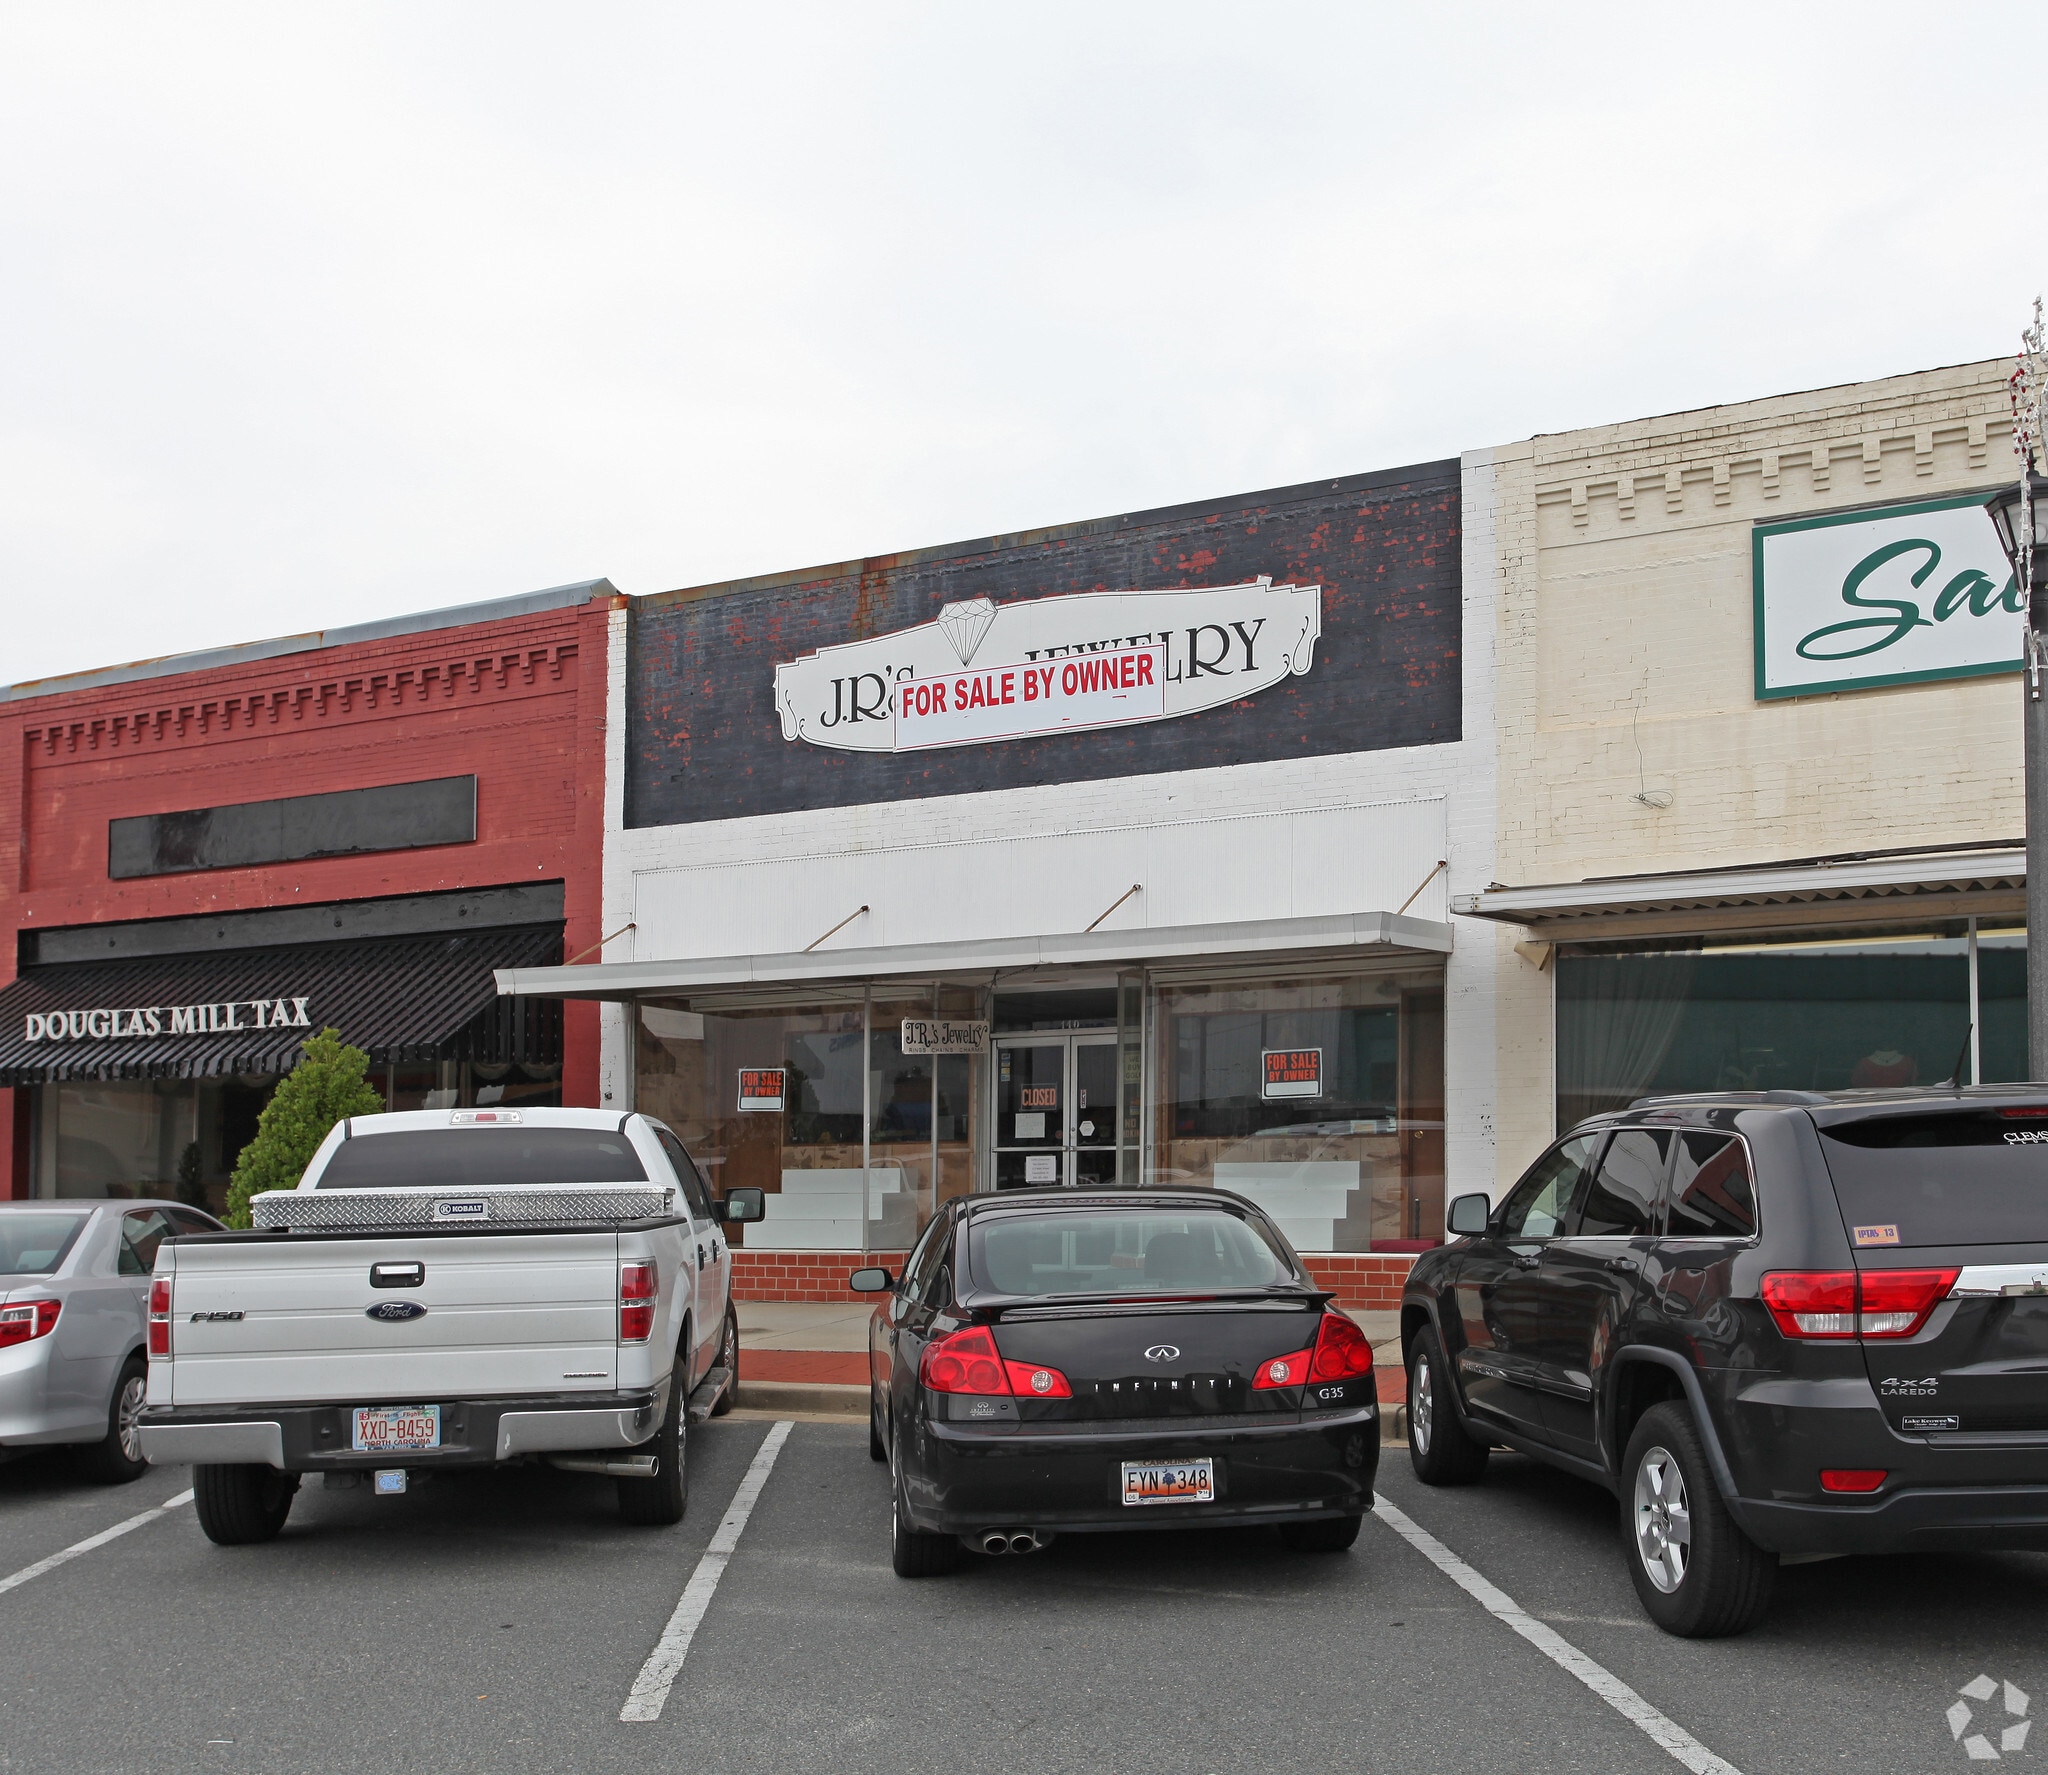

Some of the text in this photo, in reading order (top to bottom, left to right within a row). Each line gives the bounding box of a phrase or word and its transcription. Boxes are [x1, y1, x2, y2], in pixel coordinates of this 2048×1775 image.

[902, 682, 947, 718] FOR
[954, 672, 1015, 711] SALE
[1023, 666, 1055, 701] BY
[1061, 653, 1154, 696] OWNER
[25, 997, 312, 1041] DOUGLAS MILL TAX
[1061, 1020, 1080, 1029] 110
[942, 1022, 987, 1047] Jewelry
[1266, 1052, 1318, 1070] FOR SALE
[742, 1072, 782, 1086] FOR SALE
[1269, 1069, 1316, 1082] BY OWNER
[743, 1087, 780, 1096] BY OWNER
[1022, 1088, 1056, 1106] CLOSED
[1885, 1229, 1895, 1237] 13
[379, 1303, 412, 1317] Ford
[1095, 1379, 1232, 1392] INFINITI
[1880, 1377, 1939, 1387] 4x4
[1319, 1386, 1344, 1399] G35
[1881, 1388, 1937, 1396] LAREDO
[360, 1418, 434, 1440] XXD-8459
[394, 1438, 431, 1446] CAROLINA
[1127, 1469, 1208, 1492] EYN 348
